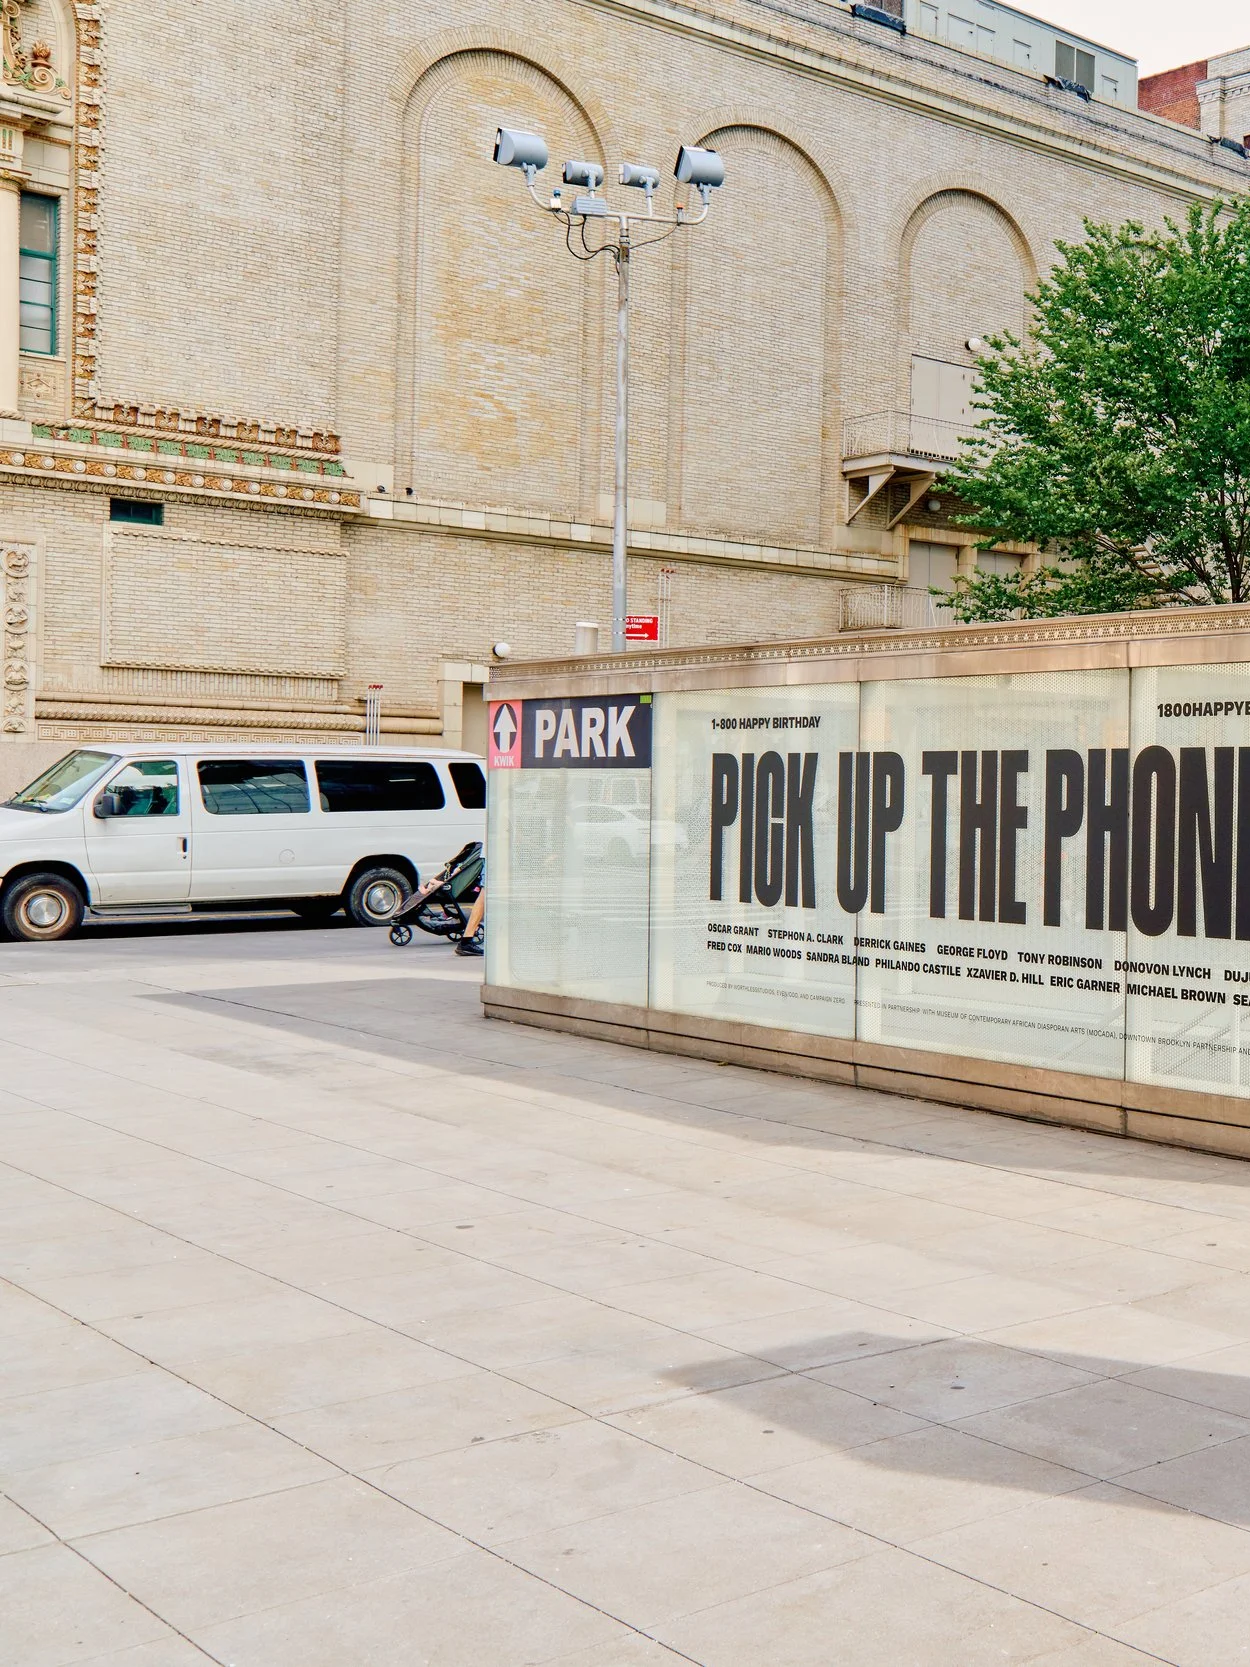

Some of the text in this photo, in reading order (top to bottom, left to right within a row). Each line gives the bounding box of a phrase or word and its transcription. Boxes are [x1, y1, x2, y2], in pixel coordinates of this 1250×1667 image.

[534, 705, 637, 758] PARK
[711, 715, 821, 731] 1-800 HAPPY BIRTHDAY
[494, 756, 515, 767] KWIK
[709, 750, 819, 910] PICK
[836, 750, 905, 915] UP
[922, 749, 1029, 925] THE
[707, 923, 732, 934] OSCAR
[733, 925, 759, 937] GRANT
[768, 929, 805, 942] STEPHON
[806, 933, 815, 943] A.
[817, 934, 844, 945] CLARK
[854, 936, 891, 951] DERRICK
[893, 940, 926, 953] GAINES
[937, 944, 975, 958] GEORGE
[977, 948, 1008, 961] FLOYD
[1017, 951, 1045, 965] TONY
[1048, 954, 1103, 970] ROBINSON
[1114, 960, 1170, 976] DONOVON
[1172, 965, 1211, 979] LYNCH
[707, 940, 726, 951] FRED
[727, 942, 742, 953] COX
[746, 945, 771, 956] MARIO
[773, 948, 802, 960] WOODS
[806, 951, 839, 964] SANDRA
[841, 954, 870, 967] BLAND
[875, 958, 920, 972] PHILANDO
[922, 963, 961, 977] CASTILE
[966, 967, 1007, 982] XZAVIER
[1009, 972, 1019, 983] D.
[1021, 973, 1045, 985] HILL
[1050, 976, 1074, 988] ERIC
[1076, 978, 1120, 993] GARNER
[1127, 983, 1178, 999] MICHAEL
[1180, 988, 1226, 1004] BROWN
[706, 980, 728, 989] PRODUCED
[800, 993, 810, 1001] AND
[810, 994, 832, 1003] CAMPAIGN
[833, 997, 846, 1005] ZERO
[888, 1003, 920, 1014] PARTNERSHIP
[922, 1008, 936, 1016] WITH
[936, 1010, 959, 1019] MUSEUM
[960, 1012, 968, 1020] OF
[968, 1014, 1012, 1025] CONTEMPORARY
[1012, 1019, 1036, 1029] AFRICAN
[1037, 1022, 1069, 1033] DIASPORAN
[1070, 1027, 1086, 1035] ARTS
[1119, 1032, 1156, 1044] DOWNTOWN
[1157, 1037, 1191, 1048] BROOKLYN
[1192, 1041, 1237, 1053] PARTNERSHIP
